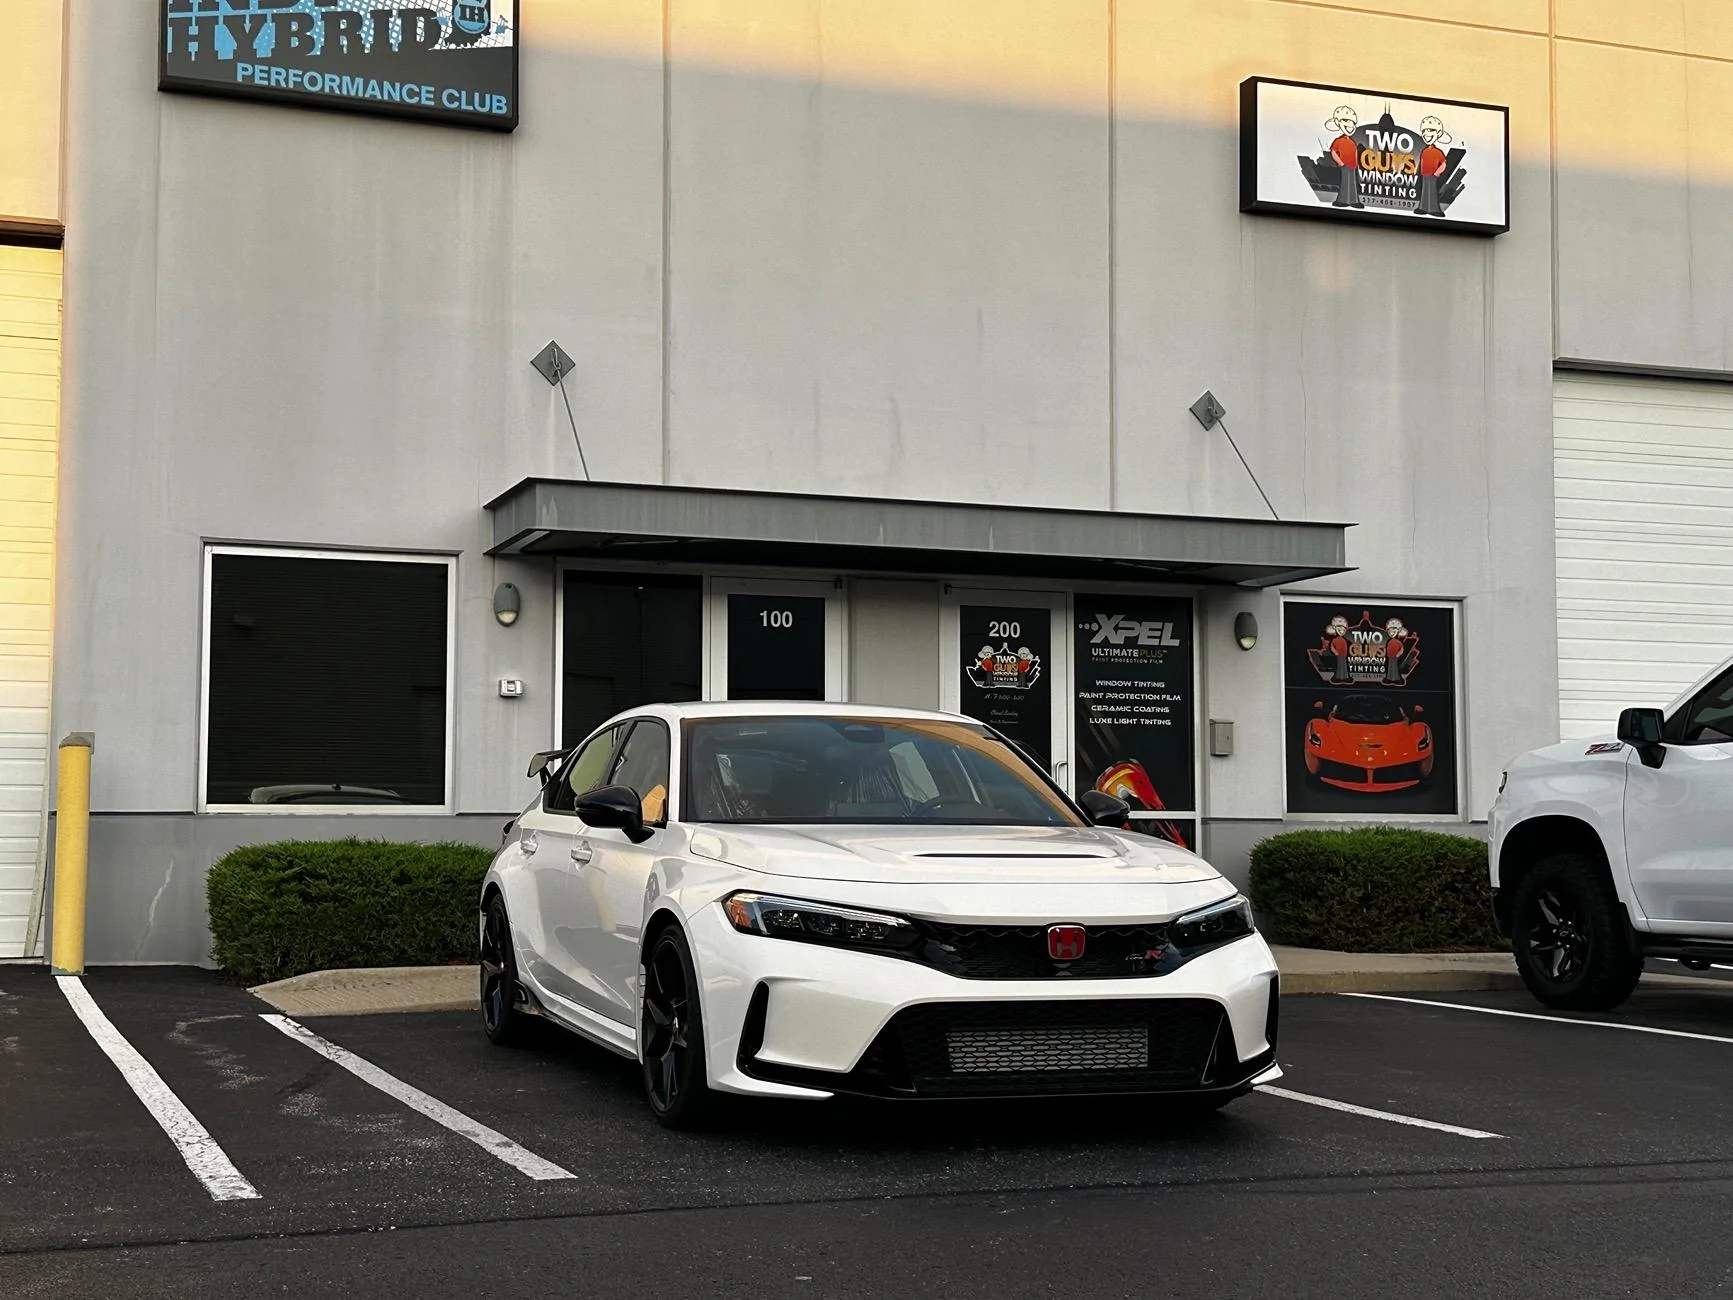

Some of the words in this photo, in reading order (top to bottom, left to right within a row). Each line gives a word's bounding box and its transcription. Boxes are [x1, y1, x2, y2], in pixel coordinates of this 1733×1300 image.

[168, 8, 442, 62] HYBRID
[236, 62, 435, 106] PERFORMANCE
[442, 88, 508, 116] CLUB
[1365, 130, 1414, 154] TWO
[1360, 149, 1417, 175] GUYS
[1358, 170, 1419, 187] WINDOW
[1360, 184, 1417, 198] TINTING
[759, 610, 793, 629] 100
[988, 621, 1021, 638] 200
[1089, 613, 1181, 647] XPEL
[1351, 631, 1383, 644] TWO
[995, 655, 1017, 664] TWO
[1349, 665, 1386, 673] TINTING
[1095, 679, 1132, 687] WINDOW
[1105, 692, 1161, 700] PROTECTION
[1161, 693, 1182, 701] FILM
[1114, 717, 1138, 725] LIGHT
[1139, 718, 1172, 726] TINTING
